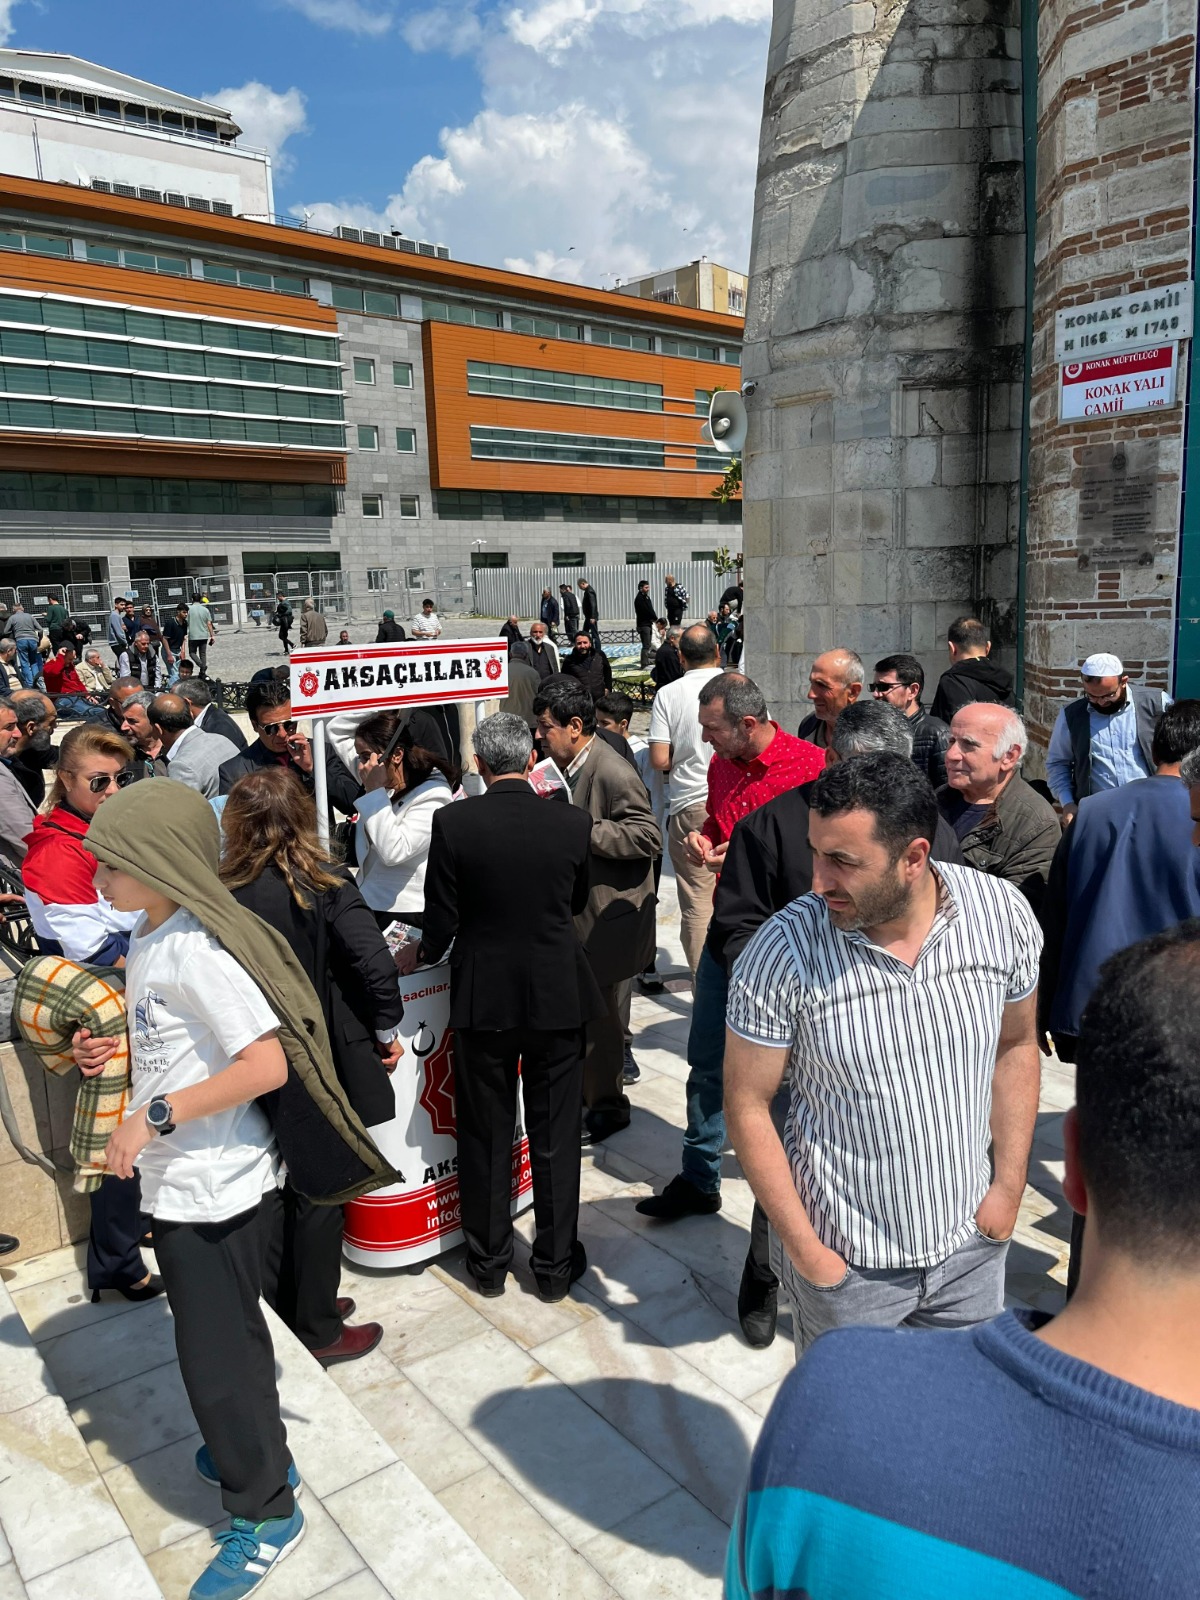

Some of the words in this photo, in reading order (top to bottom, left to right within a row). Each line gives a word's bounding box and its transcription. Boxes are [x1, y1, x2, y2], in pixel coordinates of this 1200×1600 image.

[1065, 306, 1122, 329] KONAK
[1064, 339, 1074, 351] H
[1125, 326, 1138, 339] M
[1144, 316, 1179, 336] 1748
[1085, 359, 1111, 371] KONAK
[1085, 381, 1131, 400] KONAK
[1134, 375, 1165, 392] YALI
[1085, 397, 1124, 416] CAMİİ
[324, 658, 482, 691] AKSAÇLILAR
